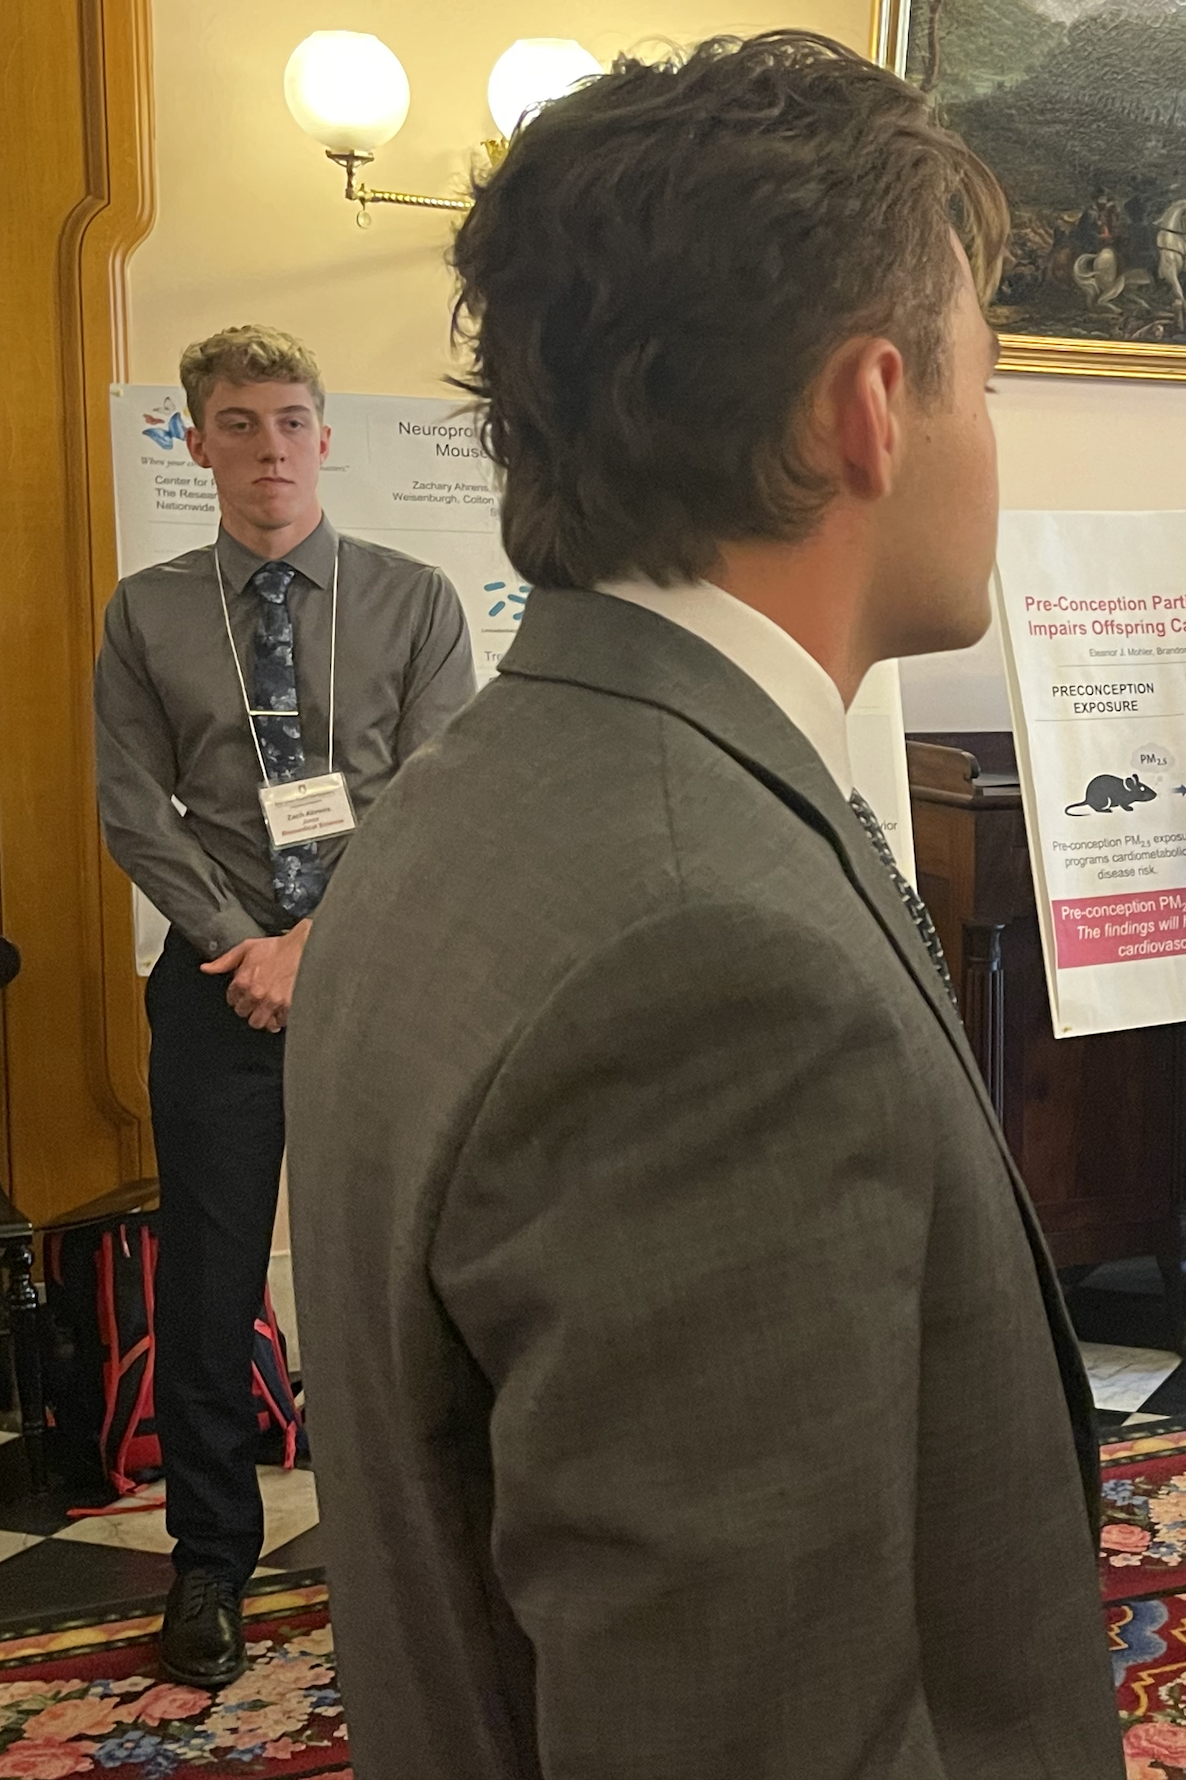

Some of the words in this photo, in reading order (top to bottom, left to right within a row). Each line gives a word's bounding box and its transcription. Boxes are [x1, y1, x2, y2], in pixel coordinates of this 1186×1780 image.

[436, 443, 488, 459] Mouse
[155, 475, 190, 486] Center
[194, 477, 207, 486] for
[412, 481, 452, 492] Zachary
[155, 488, 176, 498] The
[156, 501, 215, 512] Nationwide
[1025, 596, 1147, 614] Pre-Conception
[1028, 620, 1087, 639] Impairs
[1092, 619, 1166, 638] Offspring
[1052, 683, 1155, 697] PRECONCEPTION
[1073, 700, 1139, 714] EXPOSURE
[1052, 838, 1122, 851] Pre-conception
[1065, 855, 1109, 869] programs
[1097, 868, 1135, 880] disease
[1061, 900, 1156, 920] Pre-conception
[1077, 926, 1101, 940] The
[1105, 920, 1154, 938] findings
[1158, 916, 1179, 931] will
